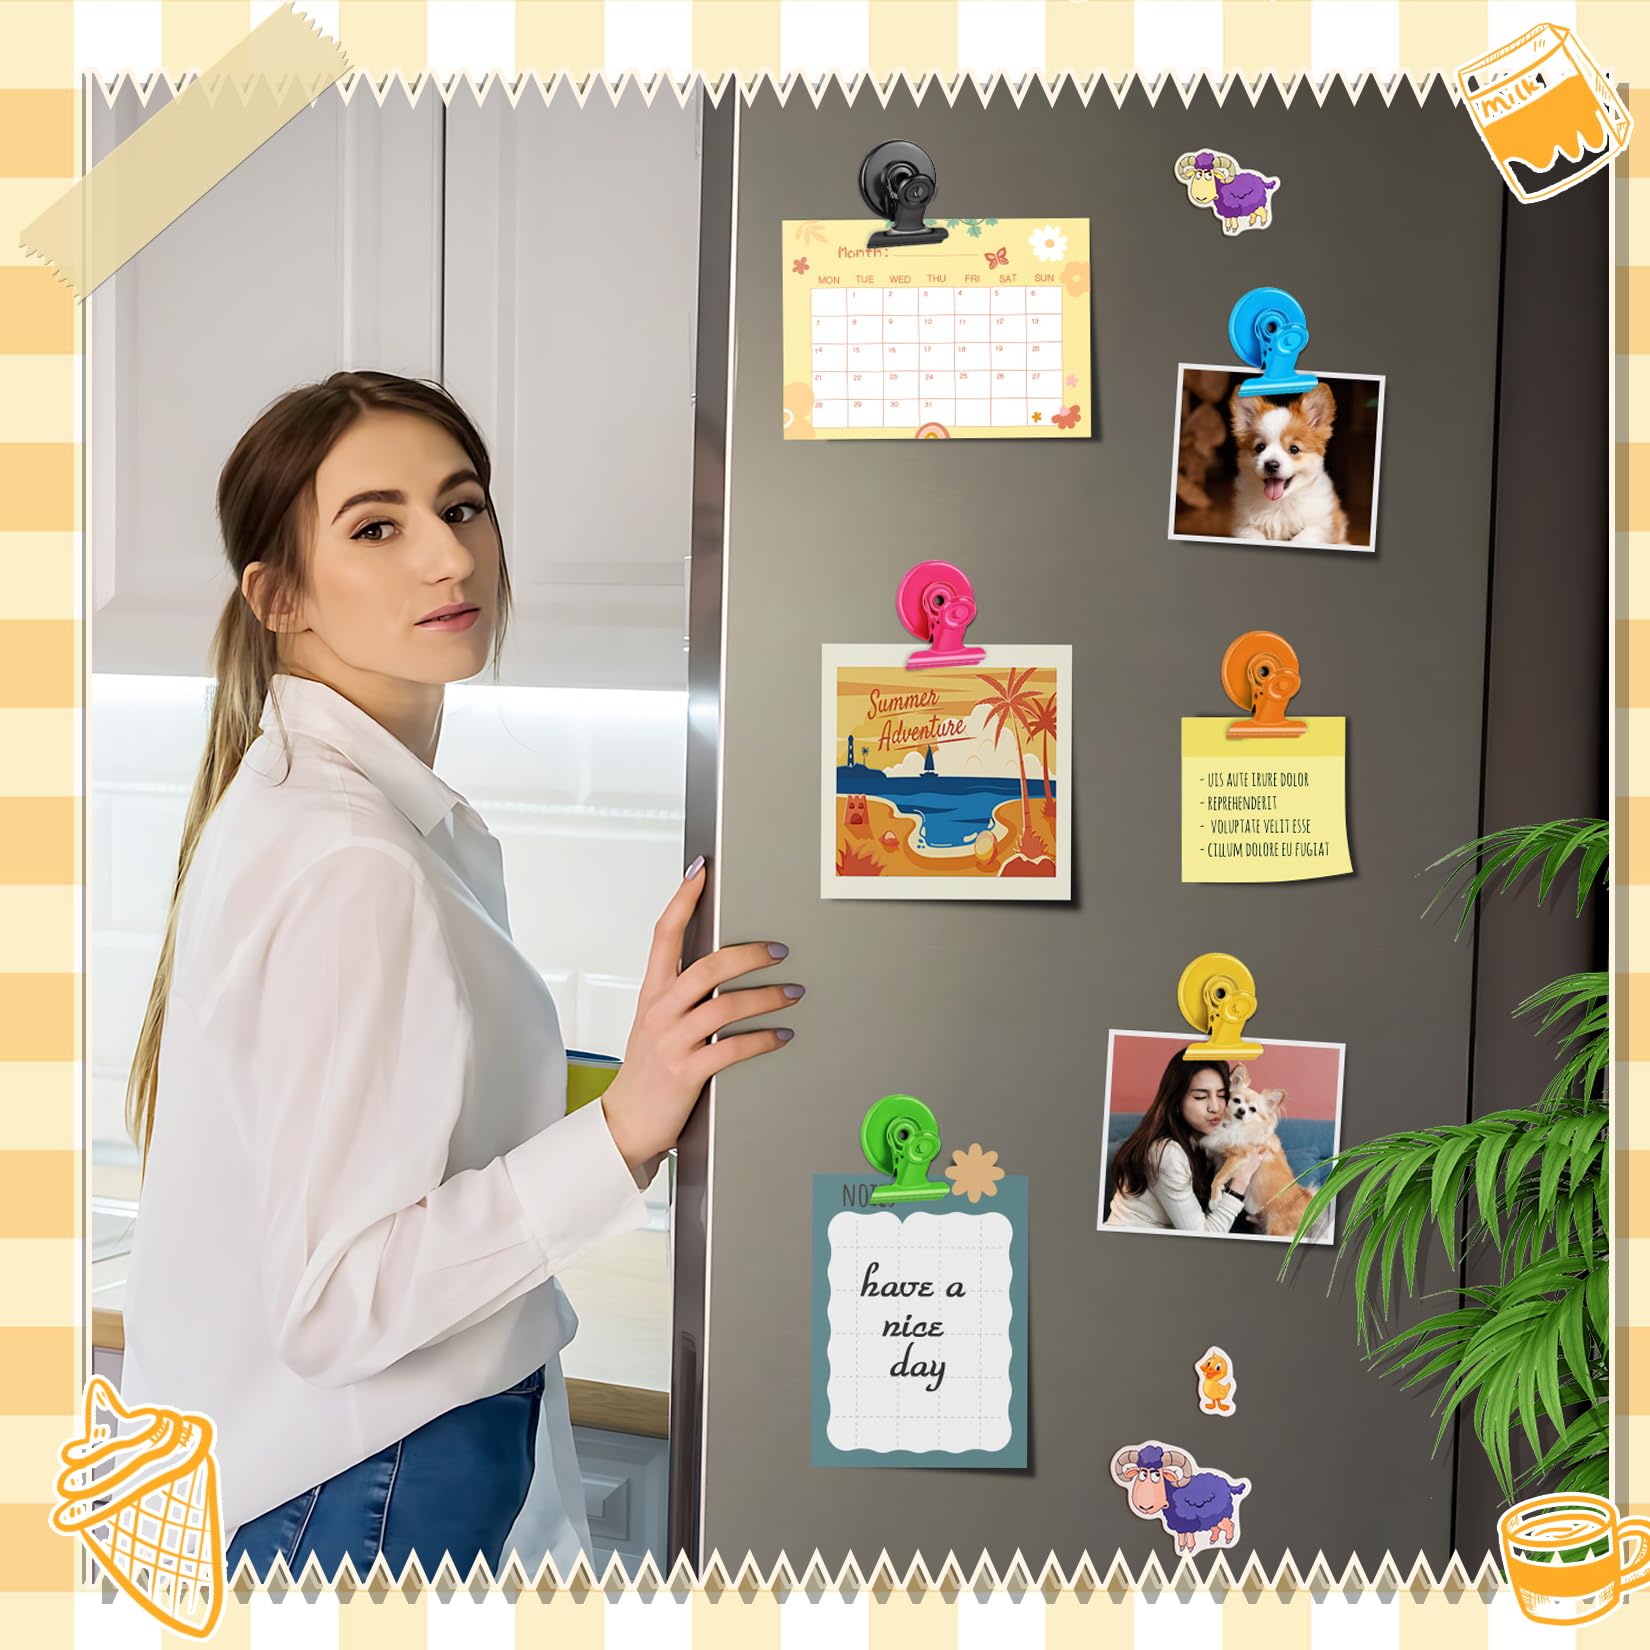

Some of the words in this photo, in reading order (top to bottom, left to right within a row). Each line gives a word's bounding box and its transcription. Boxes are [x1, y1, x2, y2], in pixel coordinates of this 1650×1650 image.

[838, 246, 889, 258] Month:
[818, 276, 840, 284] MON
[856, 275, 874, 283] TUE
[889, 275, 911, 284] WED
[928, 274, 946, 282] THU
[965, 274, 980, 283] FRI
[1000, 273, 1016, 283] SAT
[1035, 274, 1054, 282] SUN
[867, 688, 940, 720] Summer
[878, 714, 966, 751] Adventure
[1208, 772, 1223, 787] UIS
[1227, 773, 1247, 787] AUTE
[1252, 773, 1277, 786] IRURE
[1281, 773, 1309, 787] DOLOR
[1208, 796, 1276, 811] REPREHENDERIT
[1211, 819, 1260, 834] VOLUPTATE
[1264, 819, 1289, 833] VELIT
[1293, 819, 1310, 833] ESSE
[1208, 843, 1242, 857] CILLUM
[1246, 842, 1278, 856] DOLORE
[1282, 842, 1292, 856] EU
[1296, 842, 1328, 856] FUGIAT
[860, 1262, 934, 1297] have
[946, 1282, 966, 1297] a
[882, 1314, 944, 1337] nice
[889, 1342, 946, 1392] day
